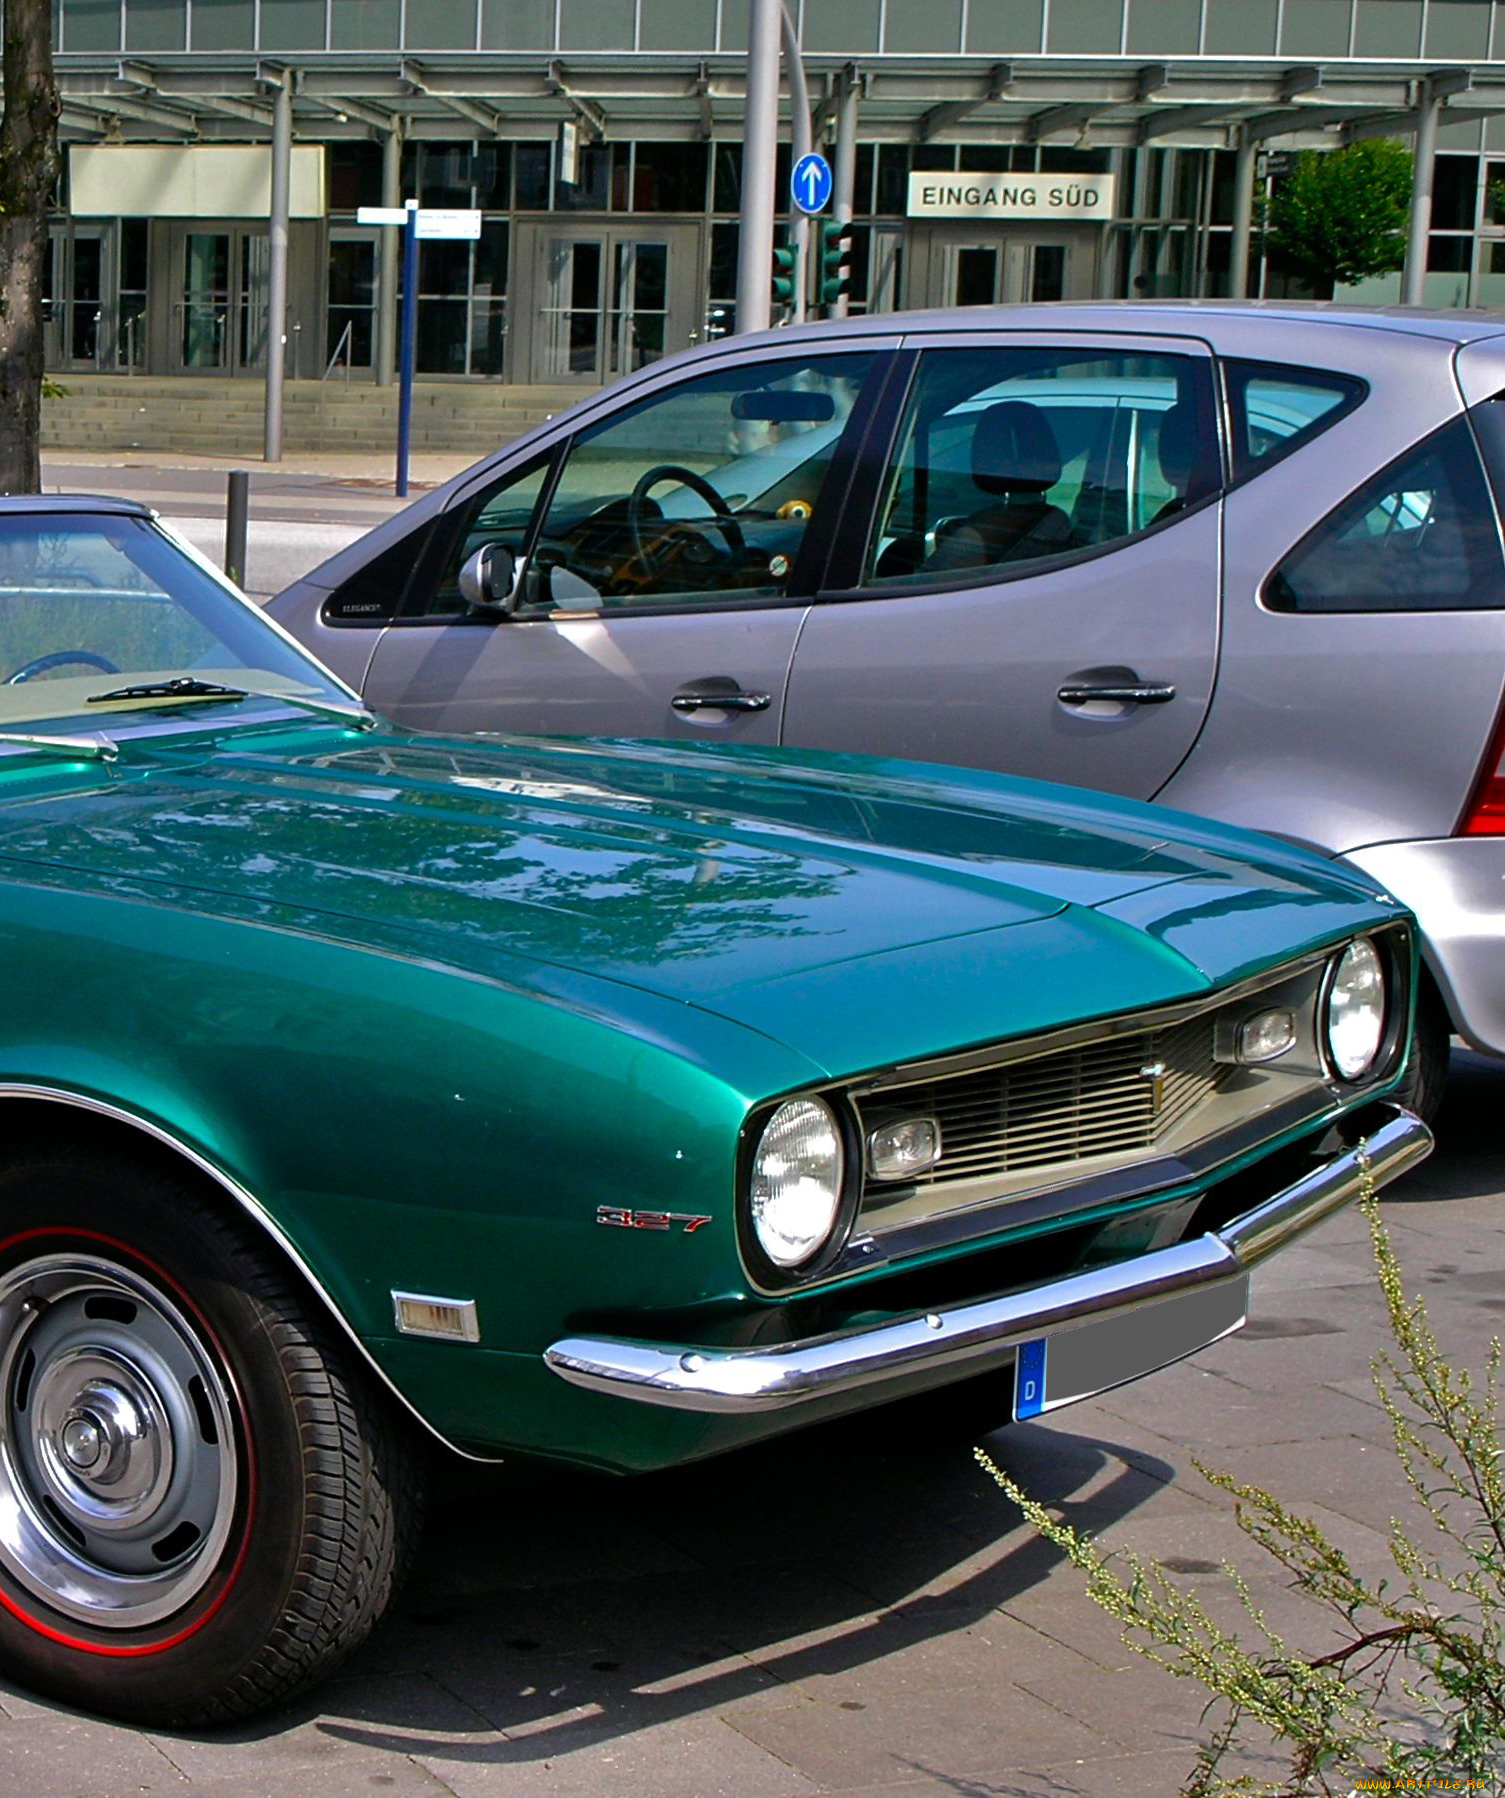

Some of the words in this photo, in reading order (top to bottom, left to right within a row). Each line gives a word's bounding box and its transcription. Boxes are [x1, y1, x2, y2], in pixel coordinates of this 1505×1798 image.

[922, 186, 1037, 206] EINGANG
[1048, 184, 1099, 208] SÜD
[597, 1205, 713, 1233] 327
[1025, 1380, 1036, 1401] D
